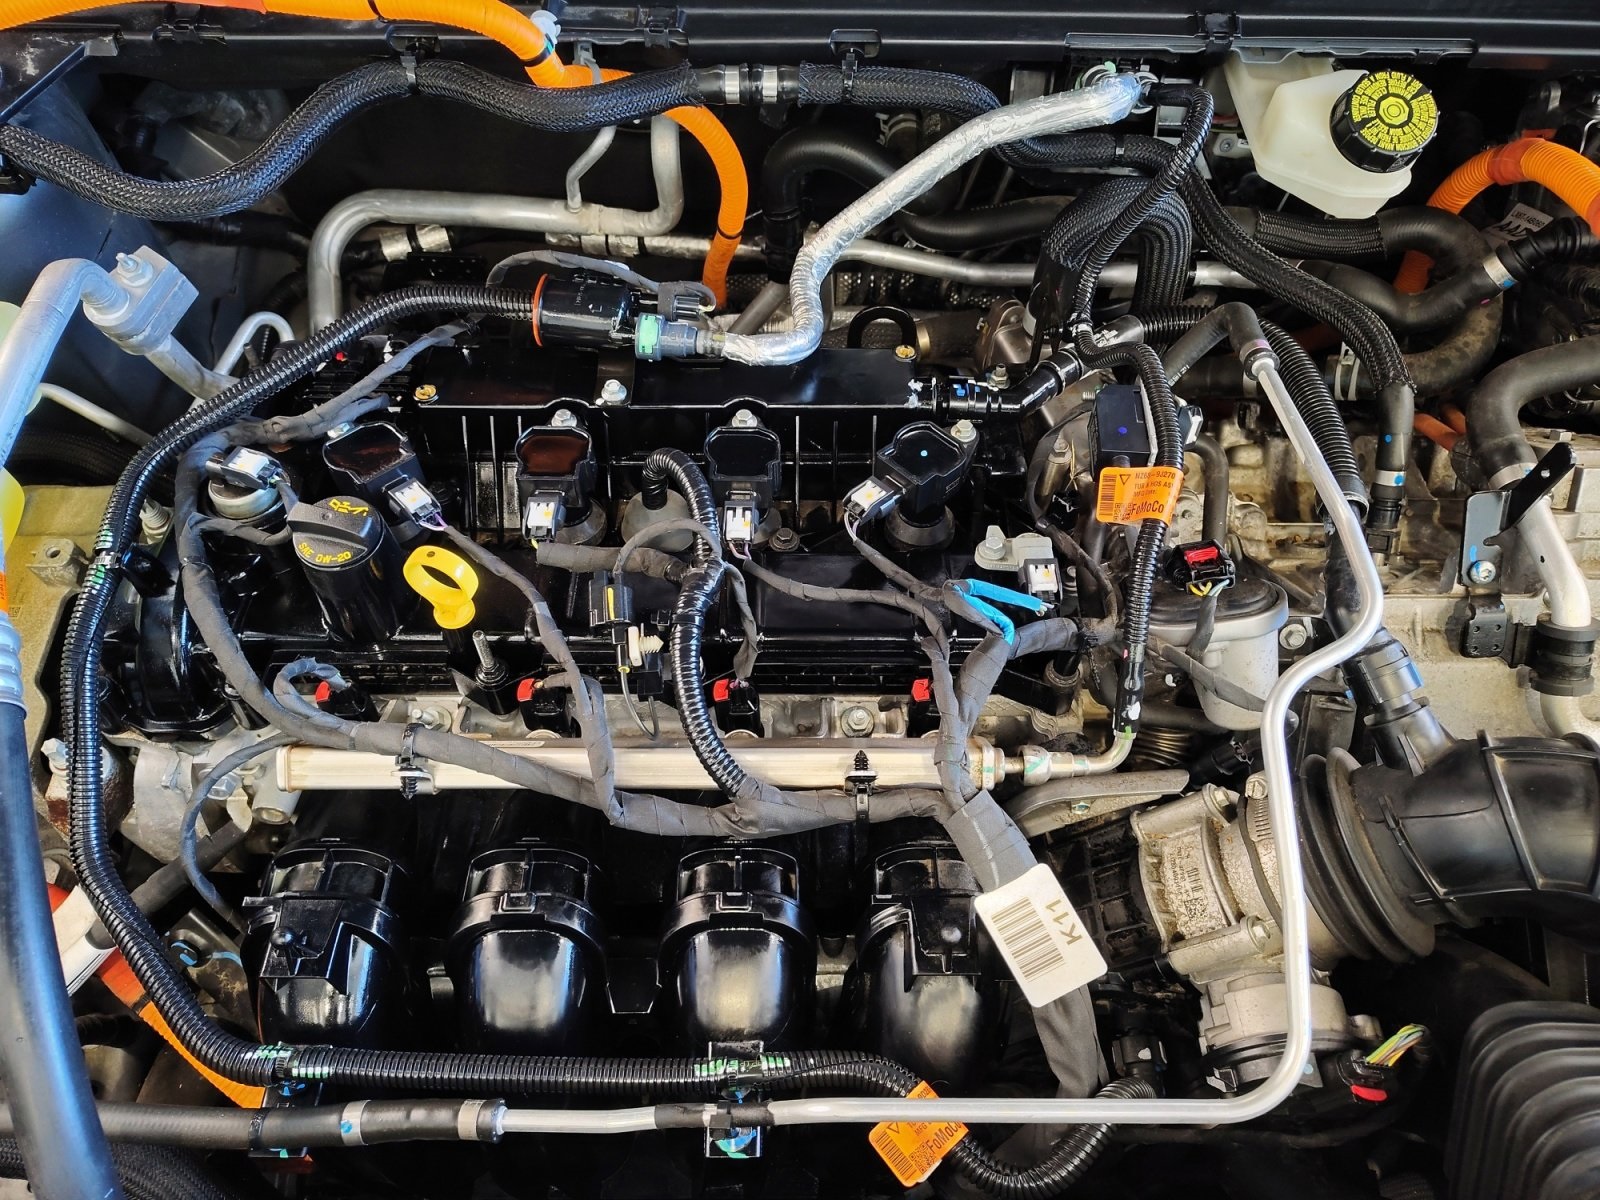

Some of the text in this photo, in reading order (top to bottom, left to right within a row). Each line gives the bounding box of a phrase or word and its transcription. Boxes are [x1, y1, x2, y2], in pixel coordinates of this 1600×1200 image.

[1130, 500, 1164, 516] FoMoCo
[298, 542, 315, 558] SAE
[1045, 899, 1082, 945] K11
